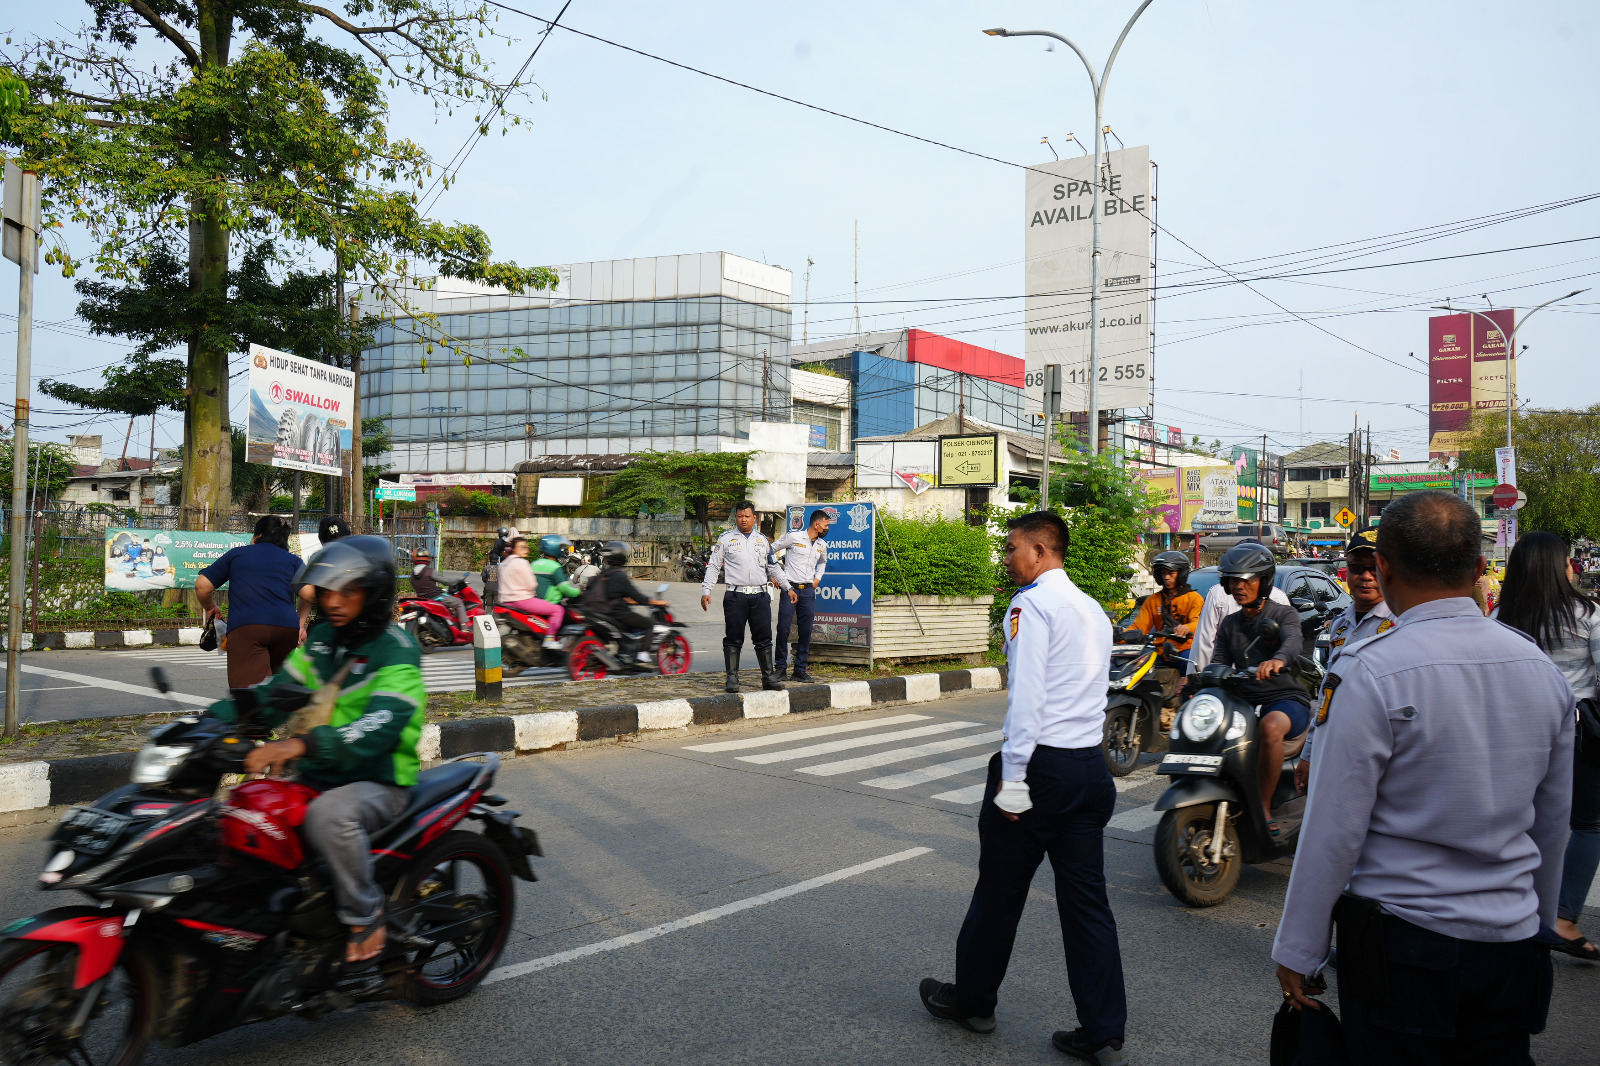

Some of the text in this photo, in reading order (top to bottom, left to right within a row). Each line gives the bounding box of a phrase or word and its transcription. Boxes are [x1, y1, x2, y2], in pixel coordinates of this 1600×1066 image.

[1053, 174, 1122, 200] SPAE
[1029, 314, 1142, 336] www.akurd.co.id
[270, 356, 353, 388] HIDUP SEHAT TANPA NARKOBA
[1025, 364, 1145, 387] 08 112 555
[285, 388, 340, 412] SWALLOW
[1187, 482, 1200, 491] MIX
[827, 540, 861, 548] KANSARI
[828, 552, 865, 560] OR KOTA
[814, 586, 842, 599] POK
[484, 620, 492, 631] 6
